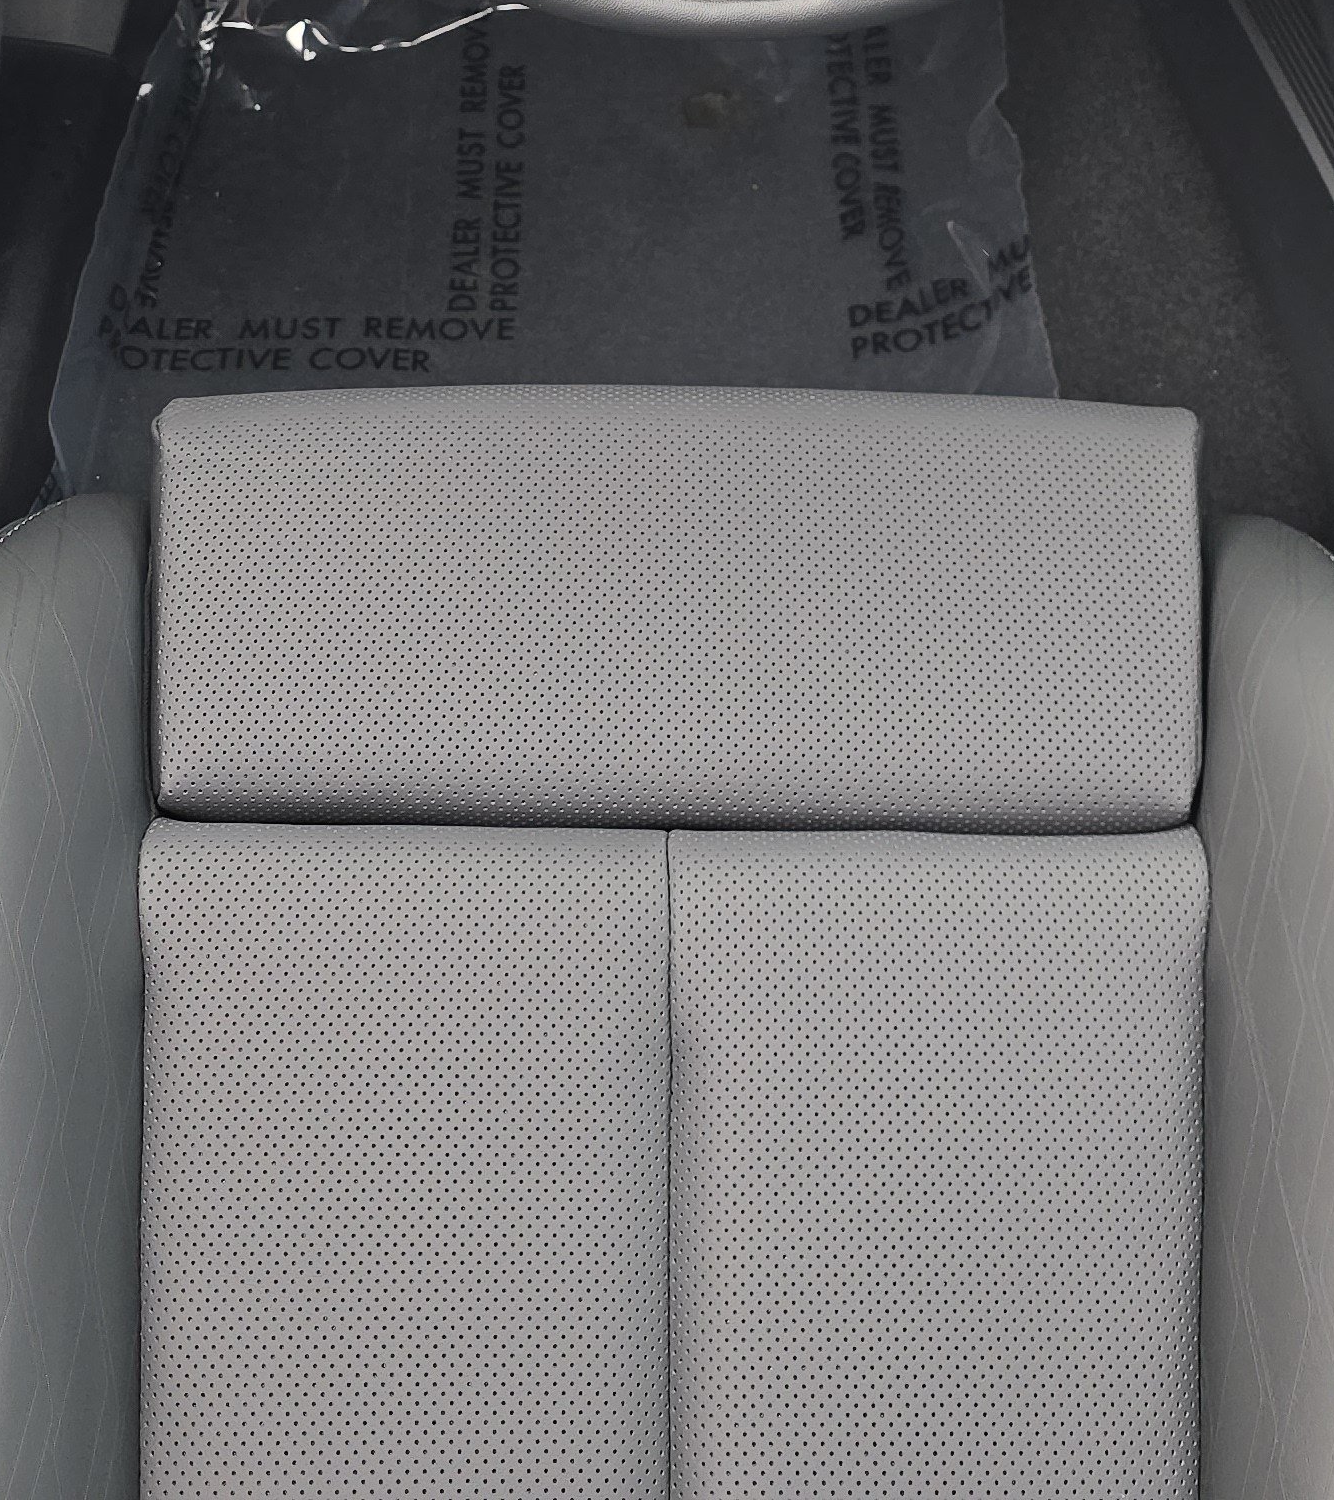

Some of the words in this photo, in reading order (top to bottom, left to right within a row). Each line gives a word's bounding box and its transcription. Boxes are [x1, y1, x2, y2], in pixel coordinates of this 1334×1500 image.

[496, 65, 527, 149] COVER
[870, 105, 904, 174] MUST
[456, 127, 486, 200] MUST
[833, 152, 867, 242] COVER
[448, 217, 482, 312] DEALER
[490, 161, 524, 312] PROTECTIVE
[240, 317, 342, 341] MUST
[365, 318, 515, 343] REMOVE
[848, 277, 969, 328] DEALER
[308, 348, 431, 373] COVER
